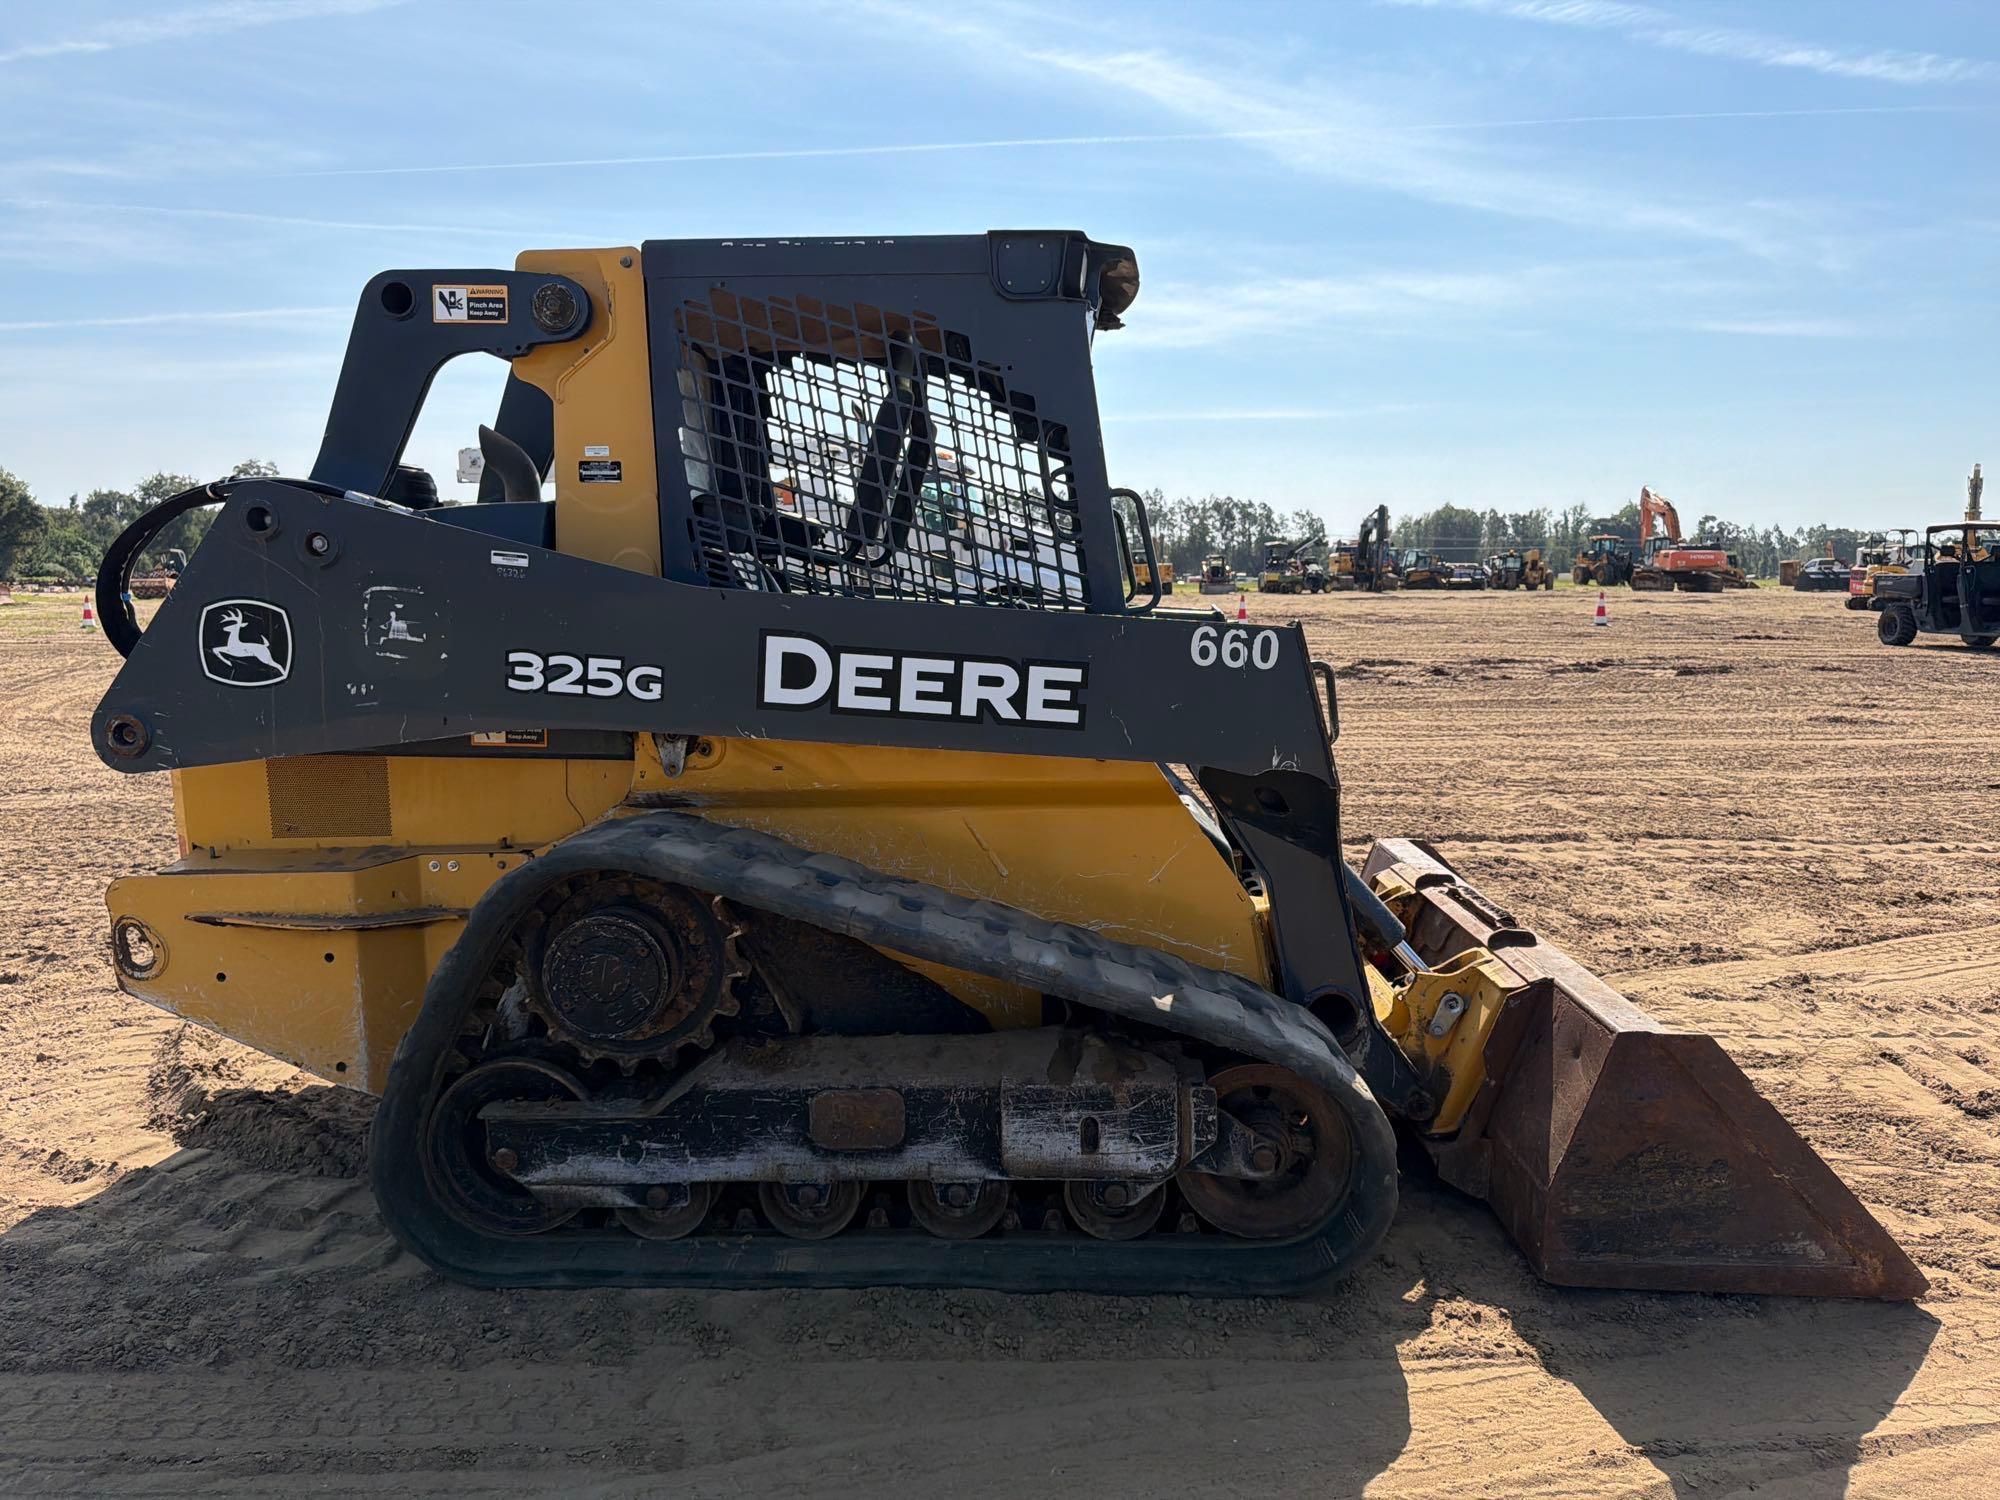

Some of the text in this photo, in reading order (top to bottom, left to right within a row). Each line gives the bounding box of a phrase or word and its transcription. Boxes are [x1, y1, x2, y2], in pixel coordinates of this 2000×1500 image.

[1190, 625, 1280, 670] 660
[507, 651, 663, 701] 325G
[763, 635, 1083, 724] DEERE
